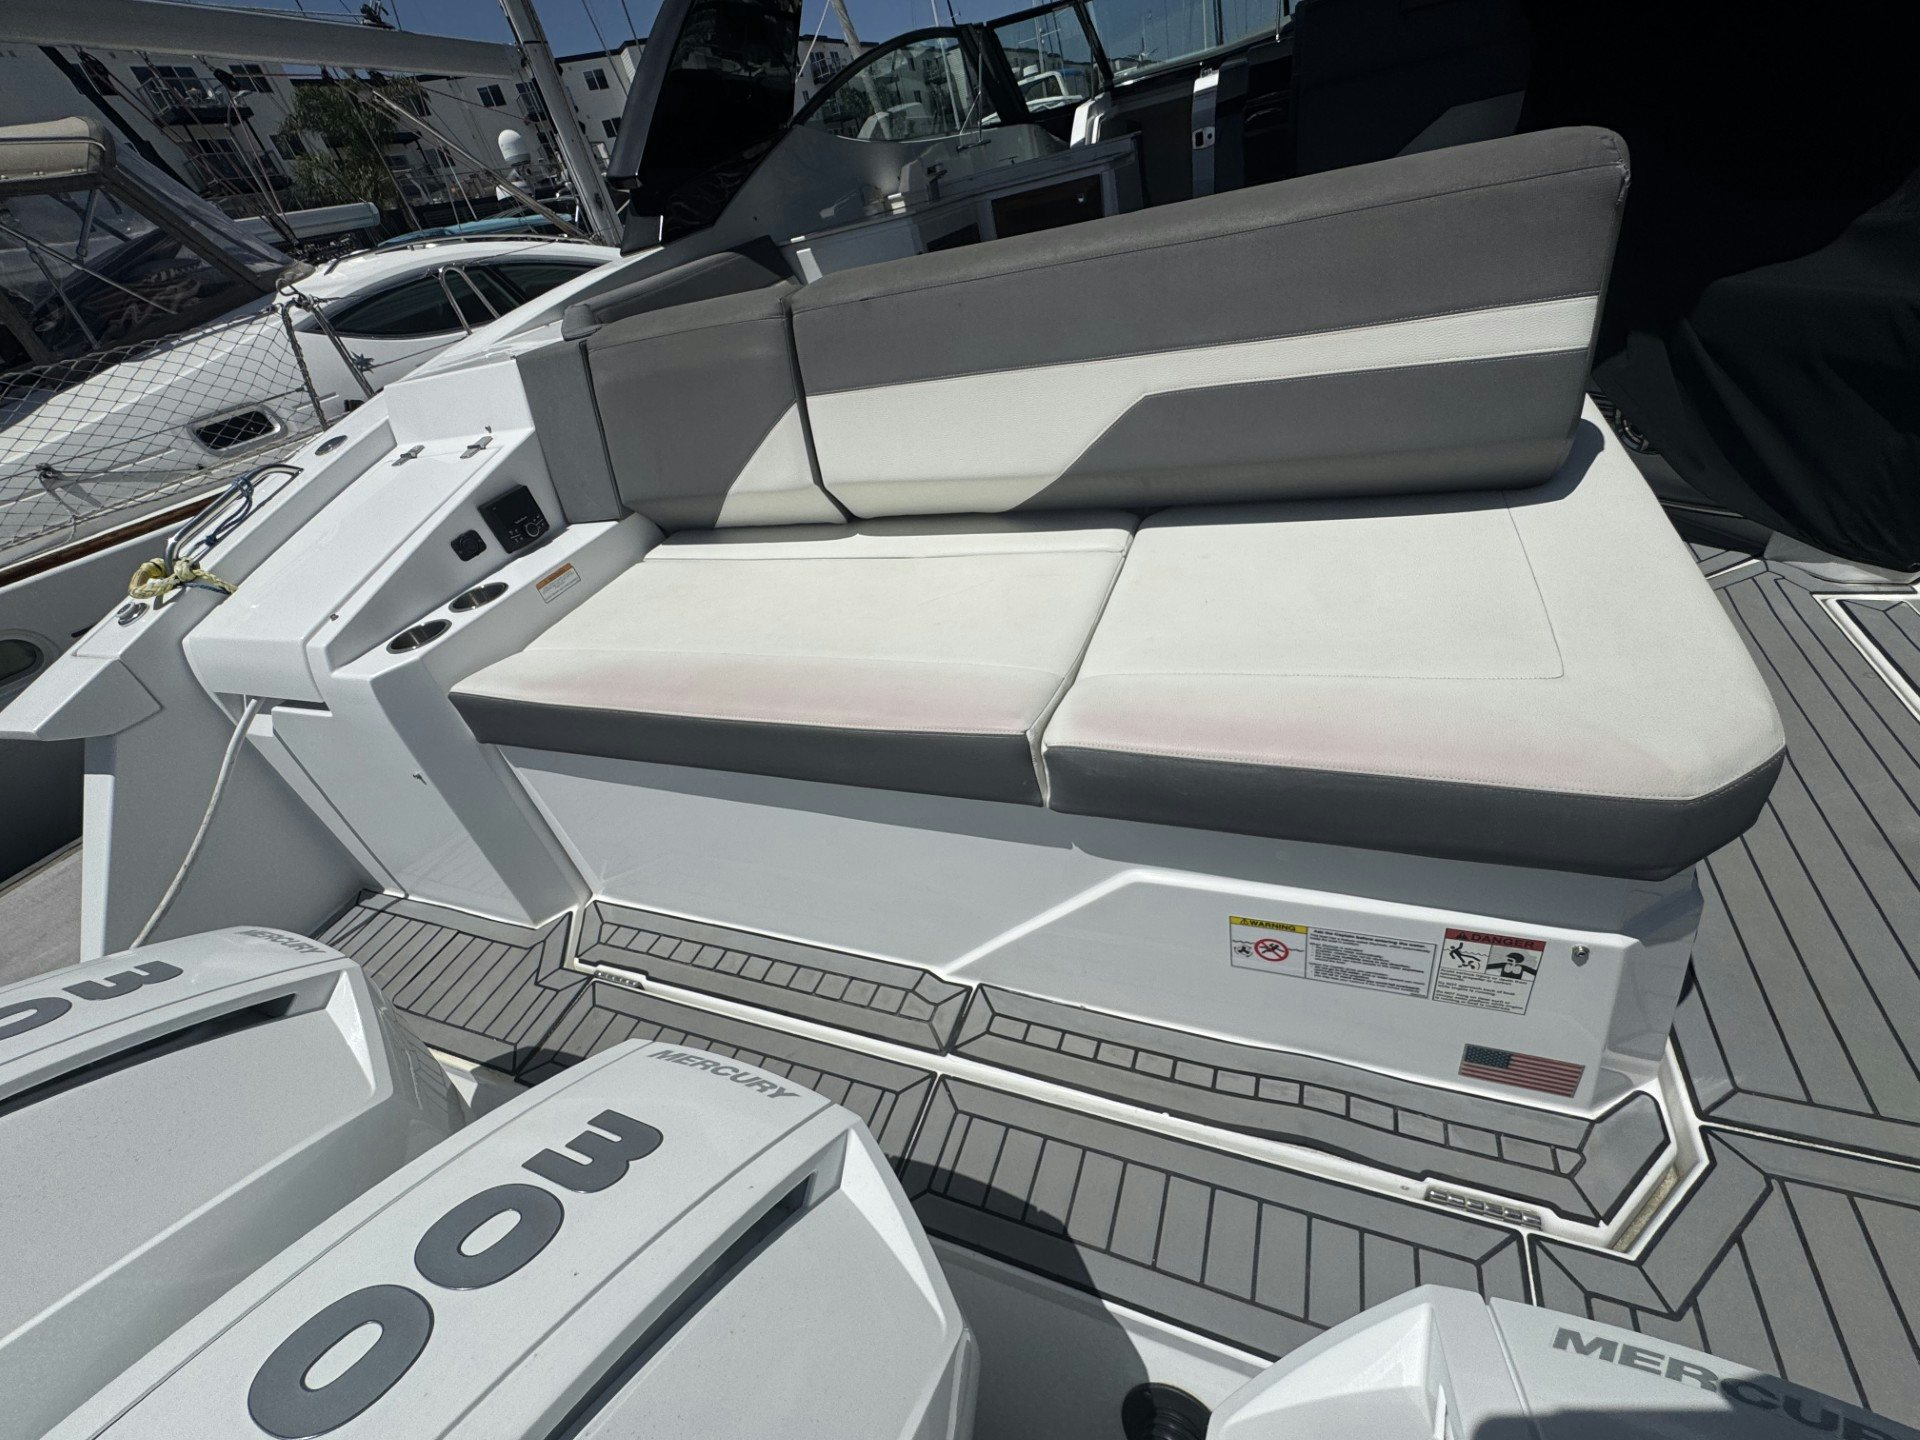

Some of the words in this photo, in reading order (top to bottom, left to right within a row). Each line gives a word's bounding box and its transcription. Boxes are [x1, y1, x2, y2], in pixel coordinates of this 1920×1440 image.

[1249, 920, 1296, 932] WARNING
[1471, 933, 1534, 949] DANGER
[649, 1050, 801, 1099] MERCURY
[247, 1108, 664, 1440] 300
